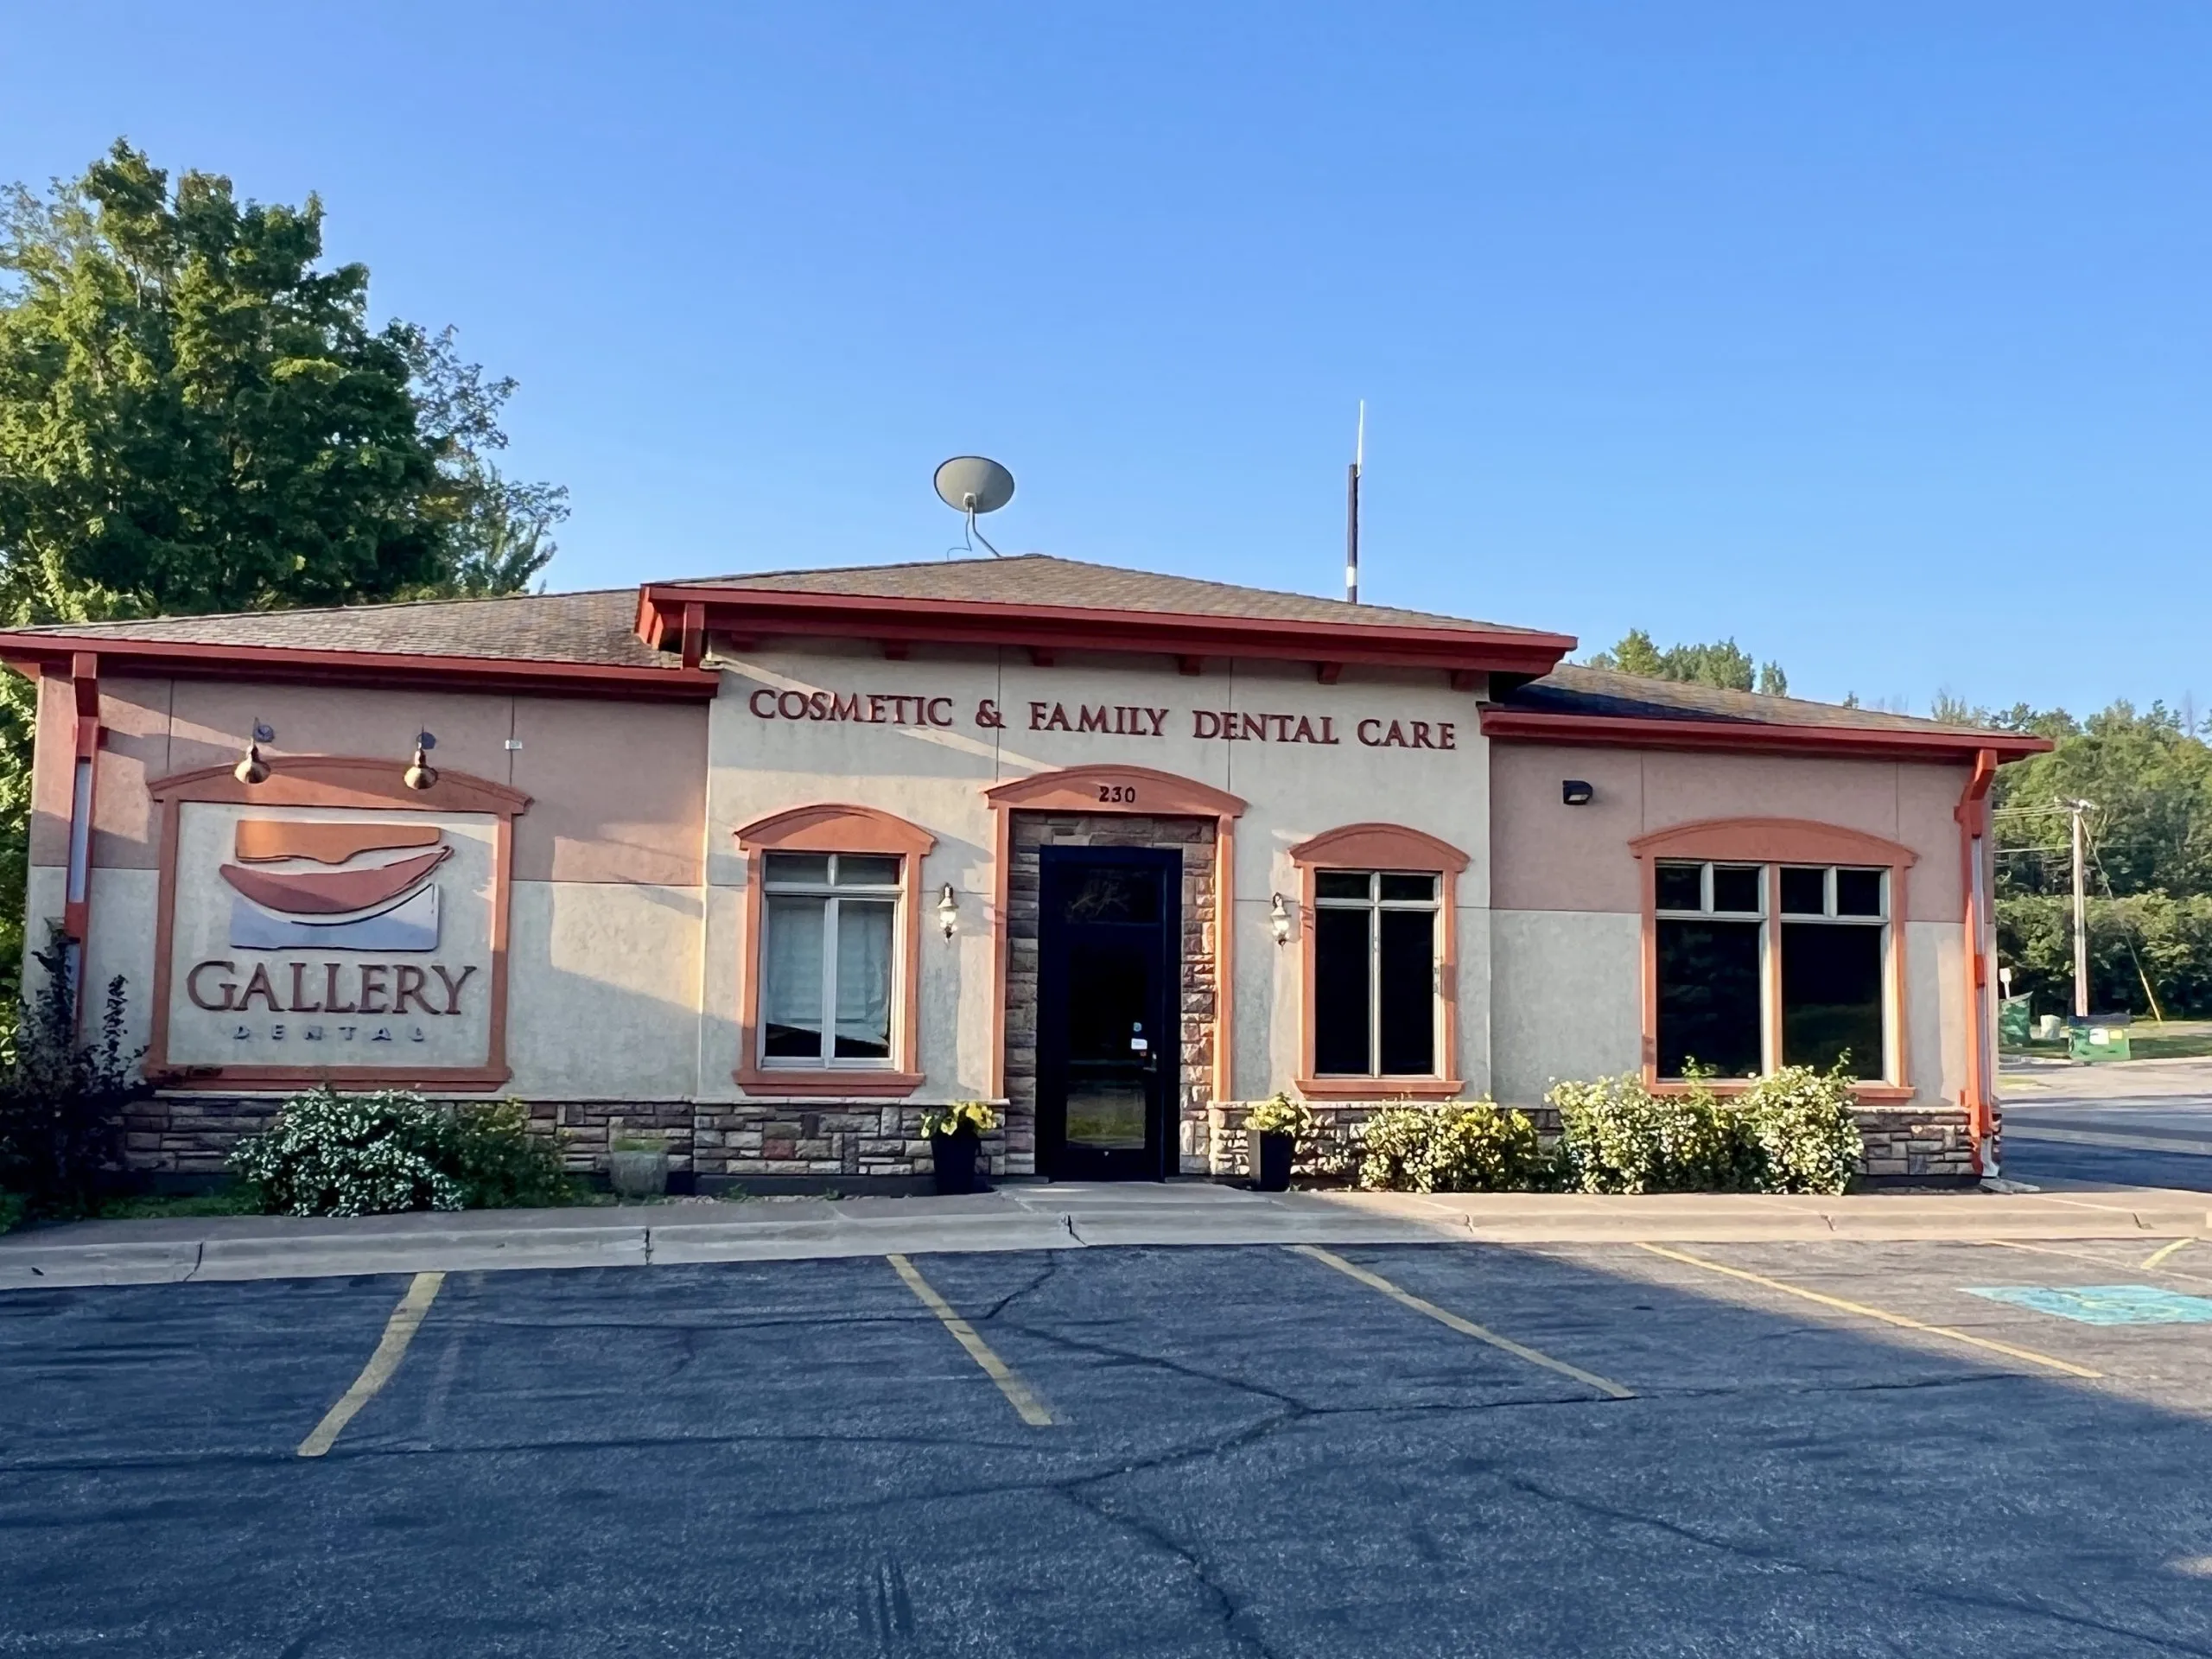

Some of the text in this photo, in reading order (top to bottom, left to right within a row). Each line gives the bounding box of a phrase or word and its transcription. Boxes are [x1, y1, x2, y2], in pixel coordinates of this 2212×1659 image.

[749, 689, 1457, 750] COSMETIC & FAMILY DENTAL CARE
[1098, 785, 1136, 804] 230
[186, 960, 478, 1015] GALLERY
[232, 1024, 427, 1042] DENTAL
